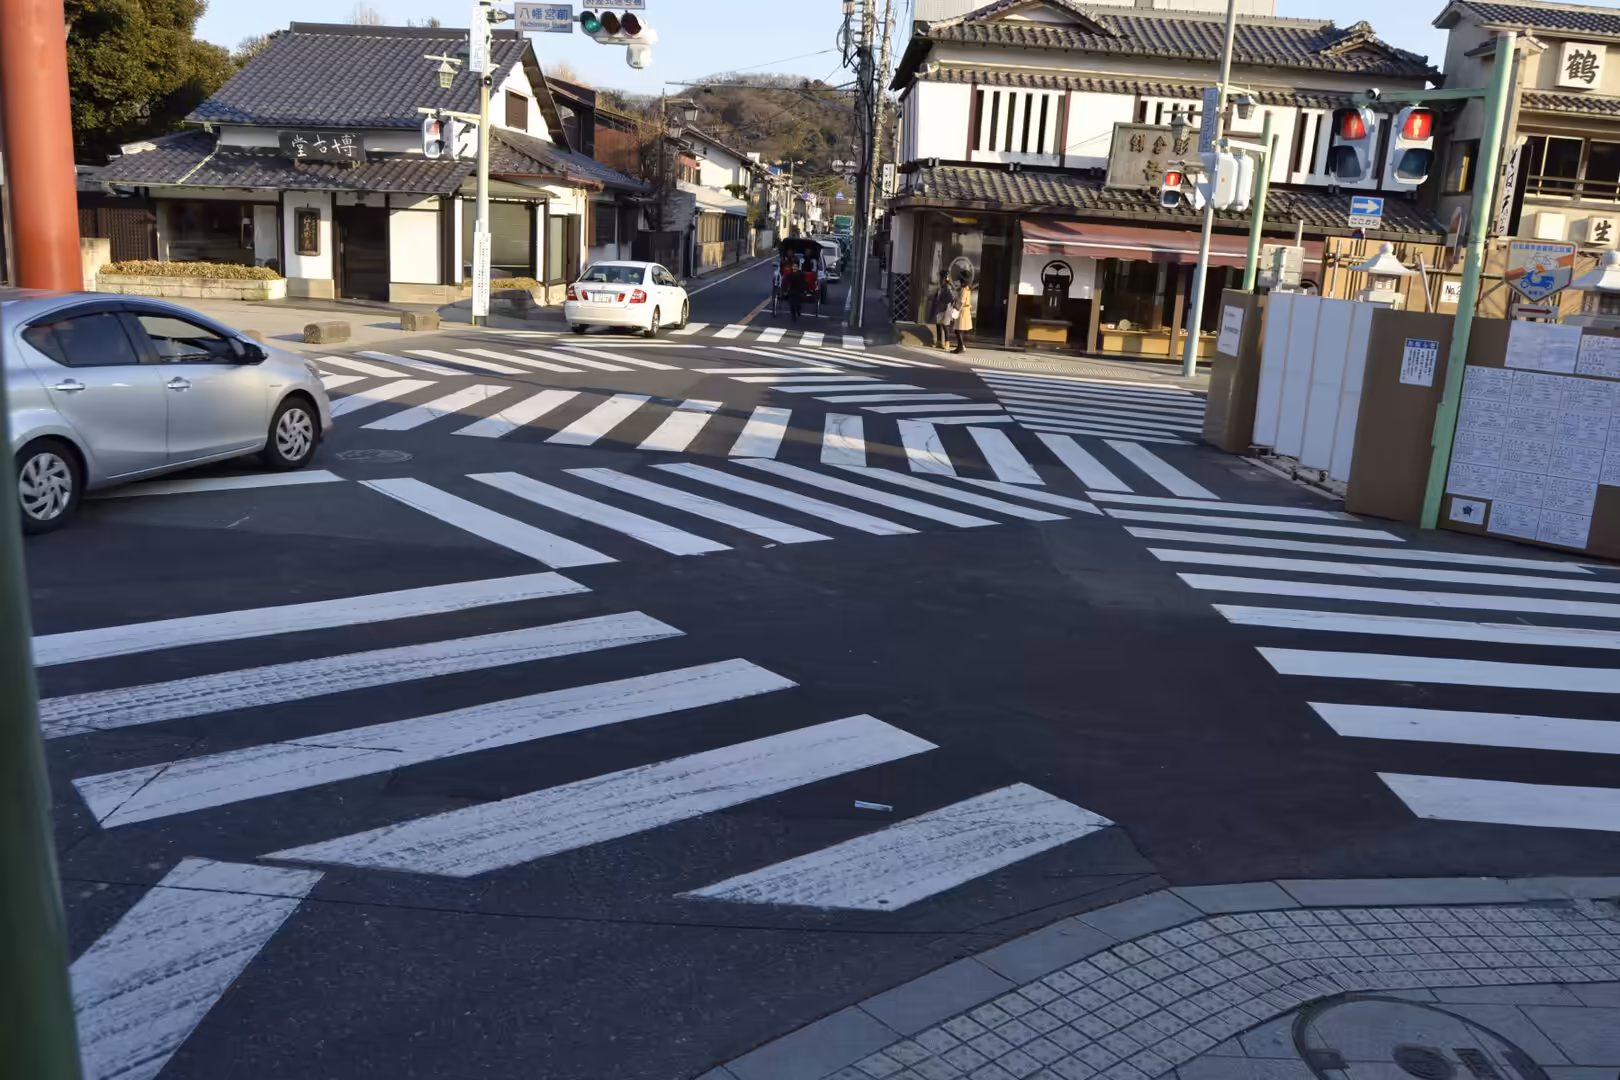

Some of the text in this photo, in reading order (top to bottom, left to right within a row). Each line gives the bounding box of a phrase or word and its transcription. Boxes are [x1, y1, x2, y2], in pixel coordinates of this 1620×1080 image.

[520, 7, 569, 21] 八幡宮前
[1566, 49, 1599, 84] 鶴
[1594, 220, 1612, 242] 生
